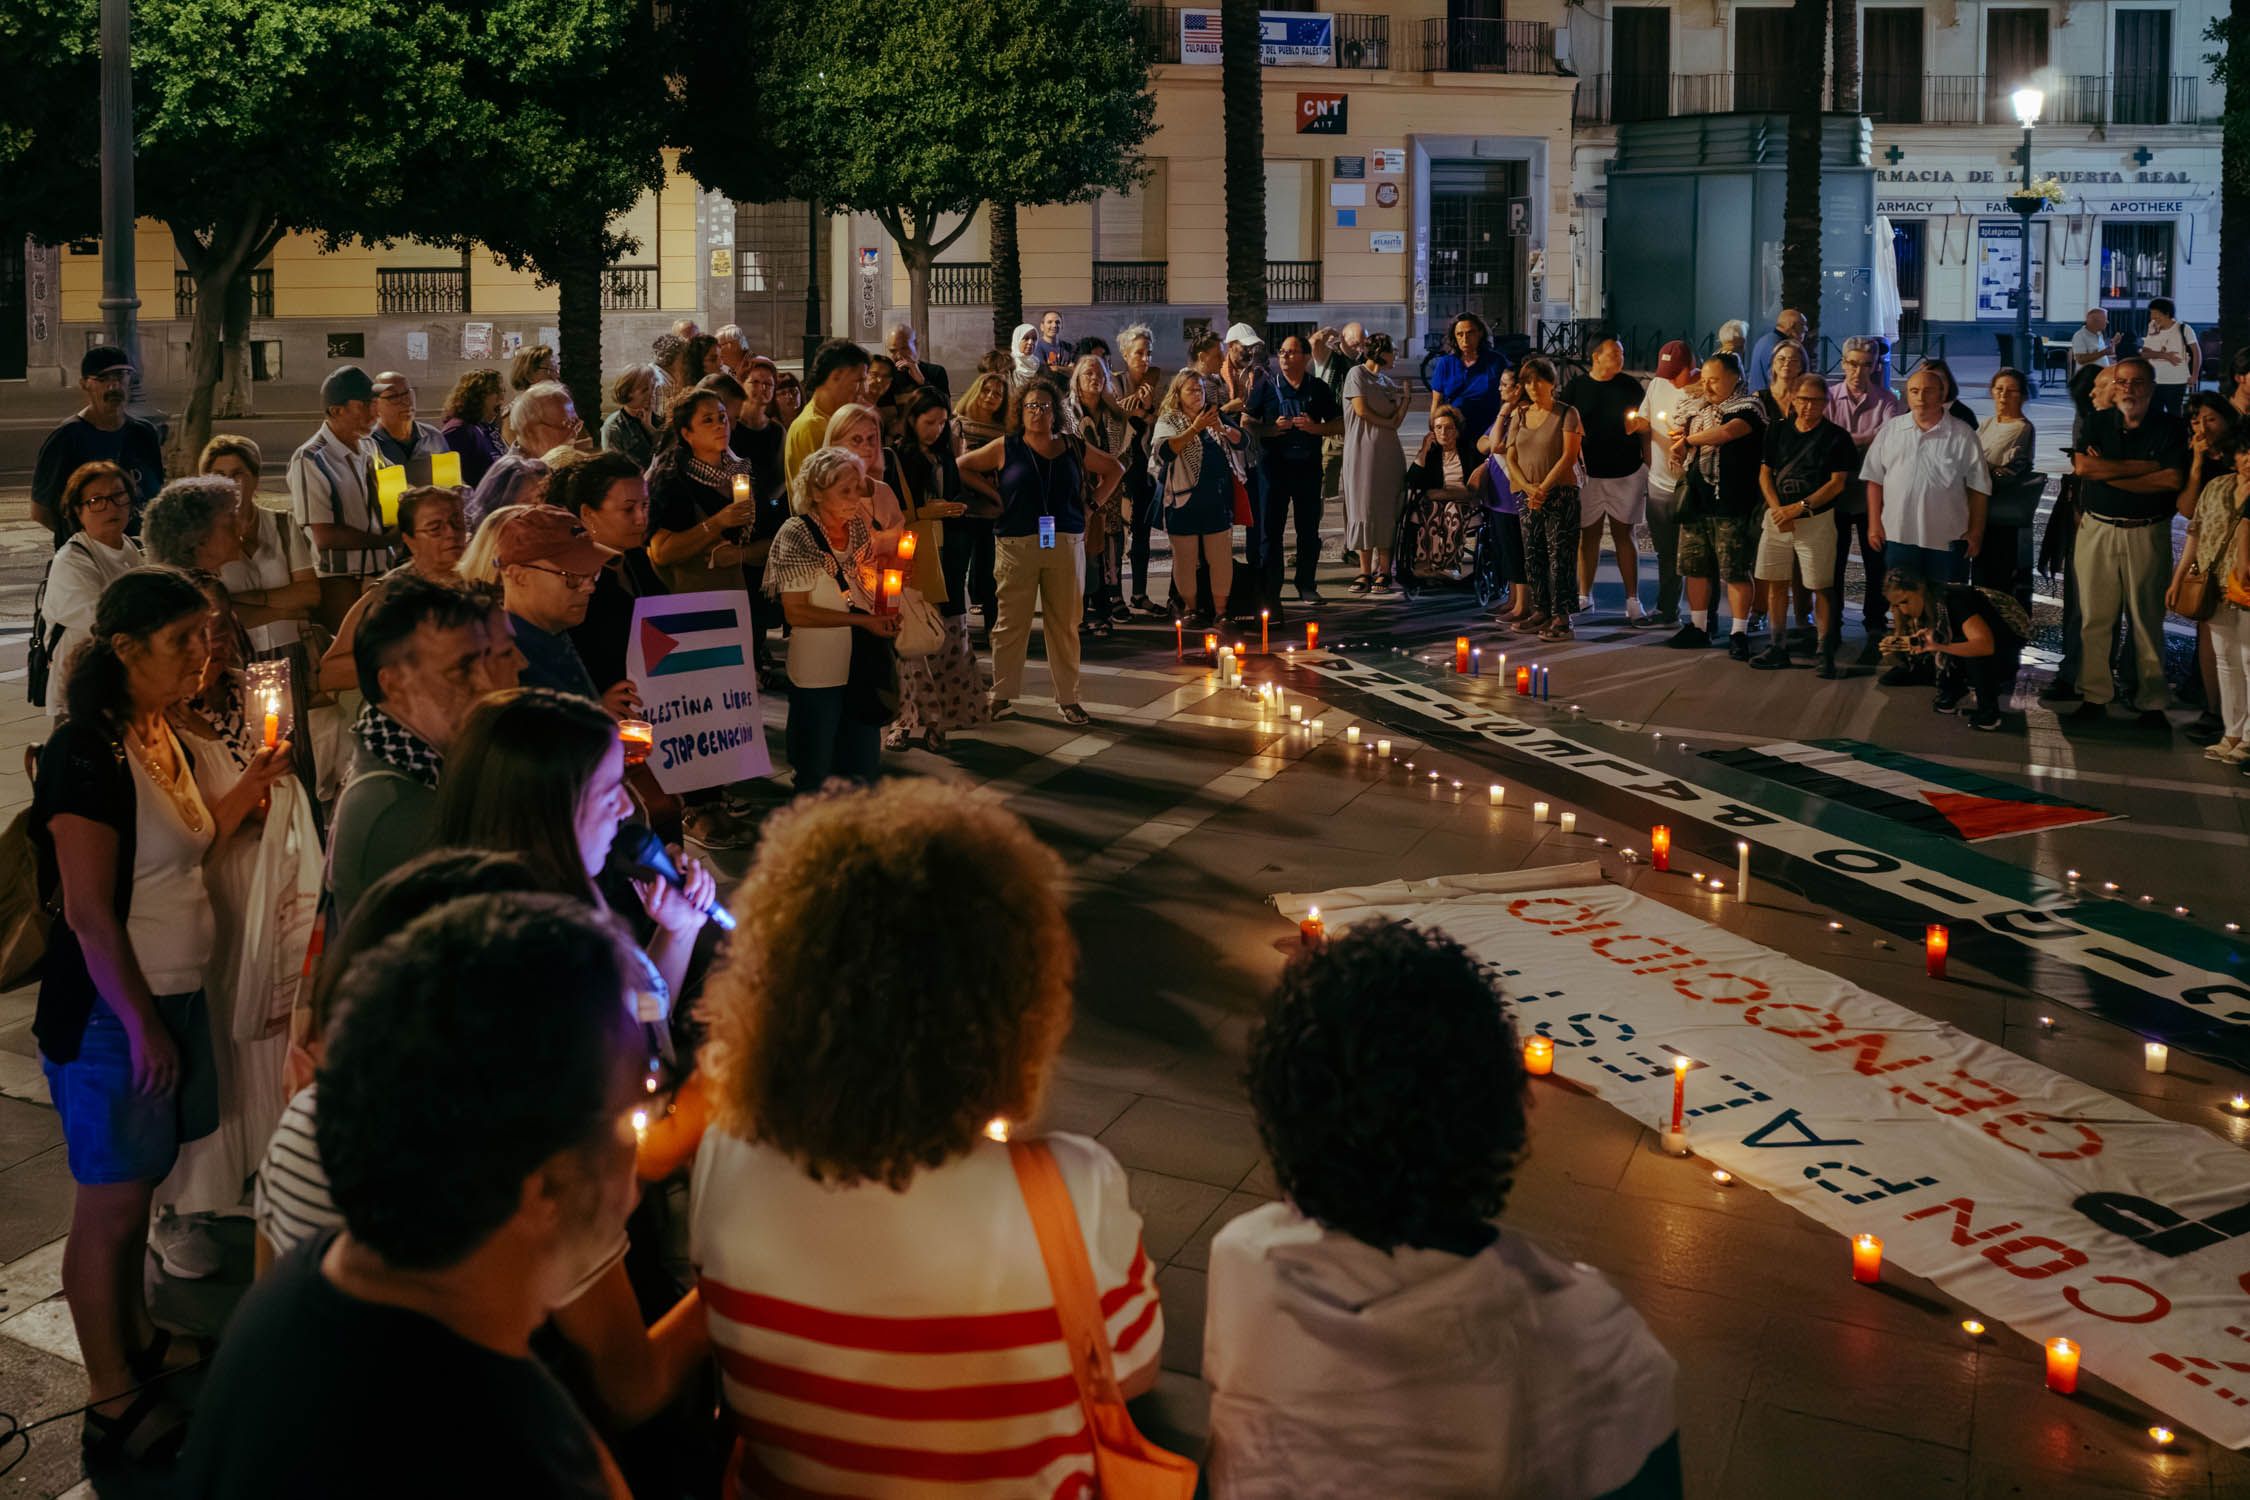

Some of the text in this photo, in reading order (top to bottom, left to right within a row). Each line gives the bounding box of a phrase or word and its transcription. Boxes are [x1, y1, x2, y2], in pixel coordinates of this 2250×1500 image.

[1185, 44, 1218, 54] CULPABLES
[1266, 46, 1277, 55] DEL
[1278, 46, 1300, 56] PUEBLO
[1304, 100, 1341, 116] CNT
[1876, 170, 1954, 182] RMACIA
[1968, 171, 1993, 183] DE
[2046, 171, 2123, 184] PUERTA
[2135, 171, 2191, 184] REAL
[1876, 202, 1933, 212] ARMACY
[1986, 202, 2055, 213] FARIA
[2110, 202, 2183, 213] APOTHEKE
[722, 688, 752, 711] LIBRE
[640, 695, 713, 726] ALESTINA
[660, 734, 695, 770] STOP
[1506, 897, 2104, 1162] GENOCIDIO
[1902, 1197, 2173, 1325] CON
